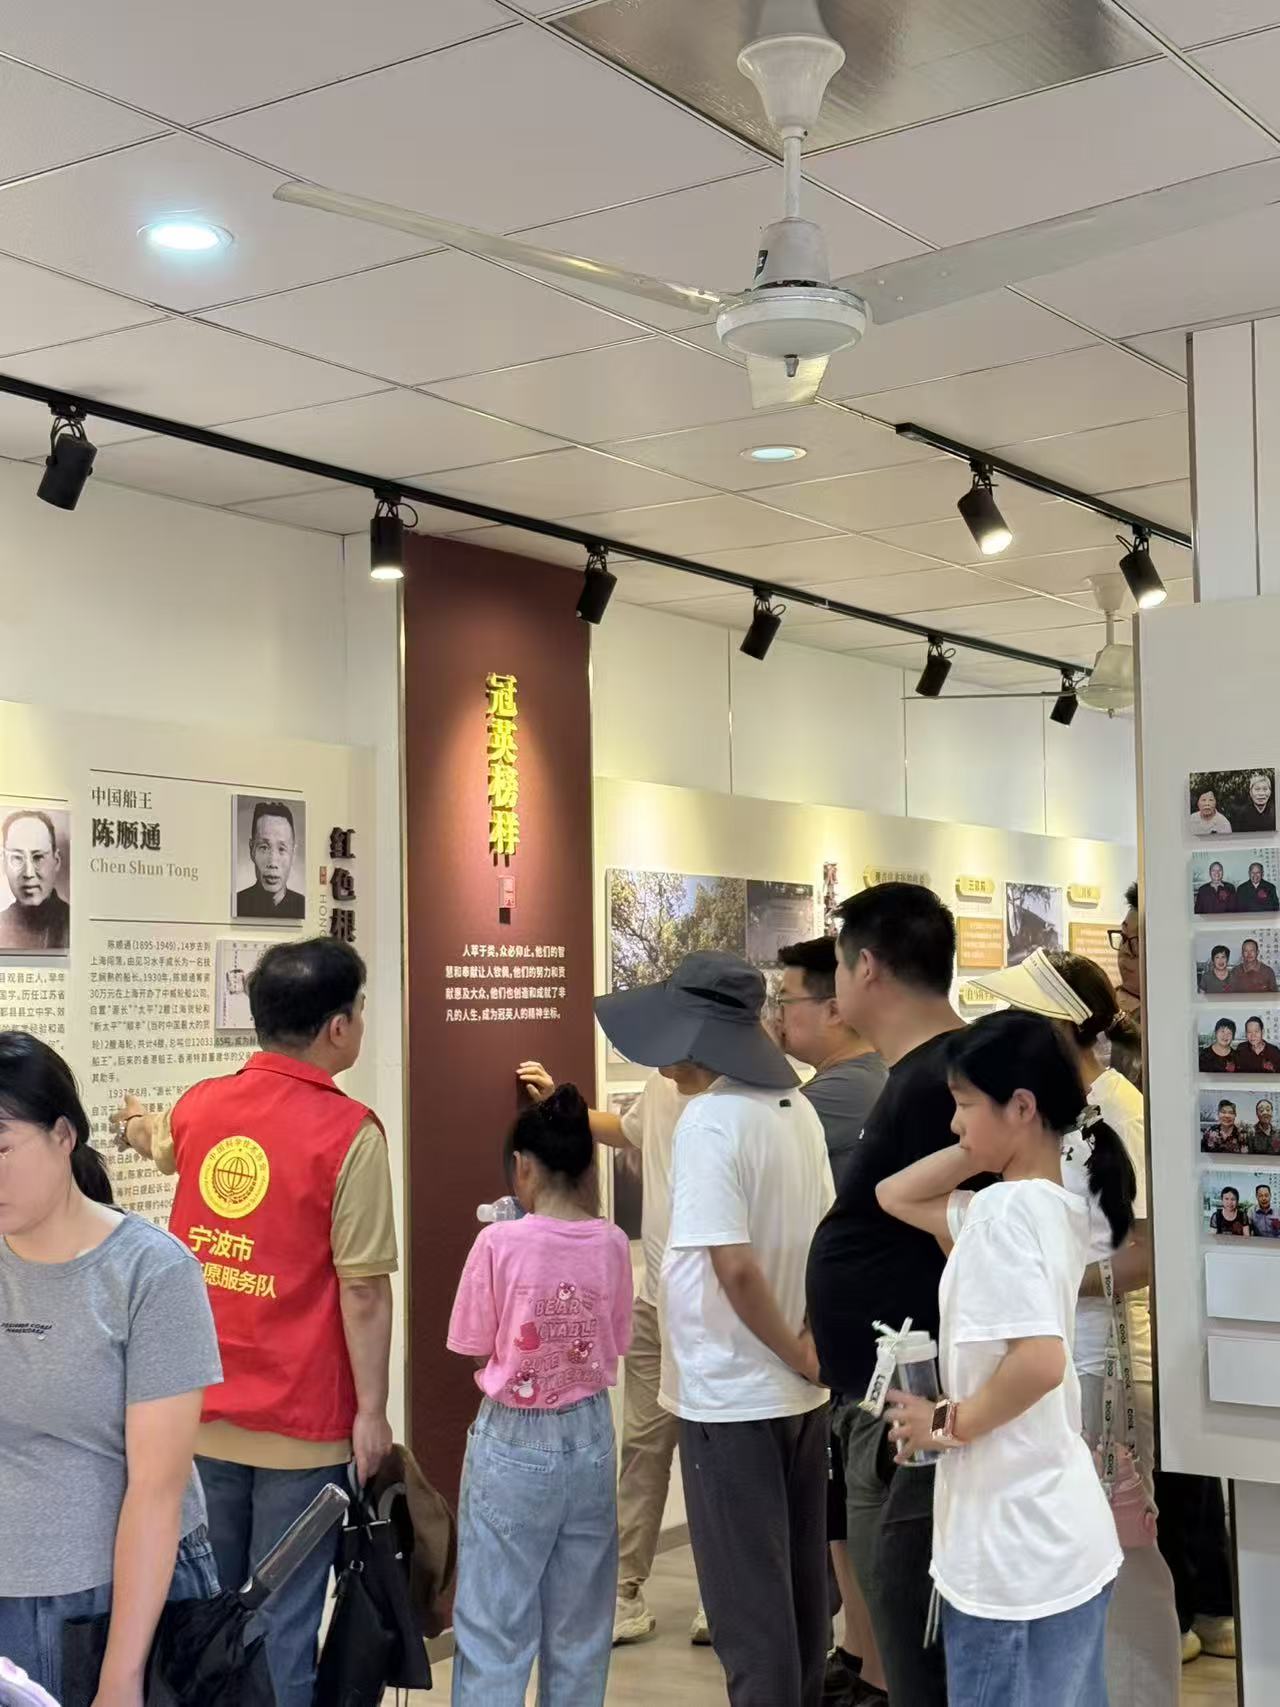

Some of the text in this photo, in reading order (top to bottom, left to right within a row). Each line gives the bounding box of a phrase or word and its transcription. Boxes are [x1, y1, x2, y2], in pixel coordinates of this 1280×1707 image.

[487, 672, 520, 857] 冠英榜样
[91, 786, 153, 809] 中国船王
[91, 817, 162, 851] 陈顺通
[90, 857, 199, 881] Chen Shun Tong
[188, 1225, 255, 1261] 宁波市
[203, 1261, 277, 1298] 愿服务队
